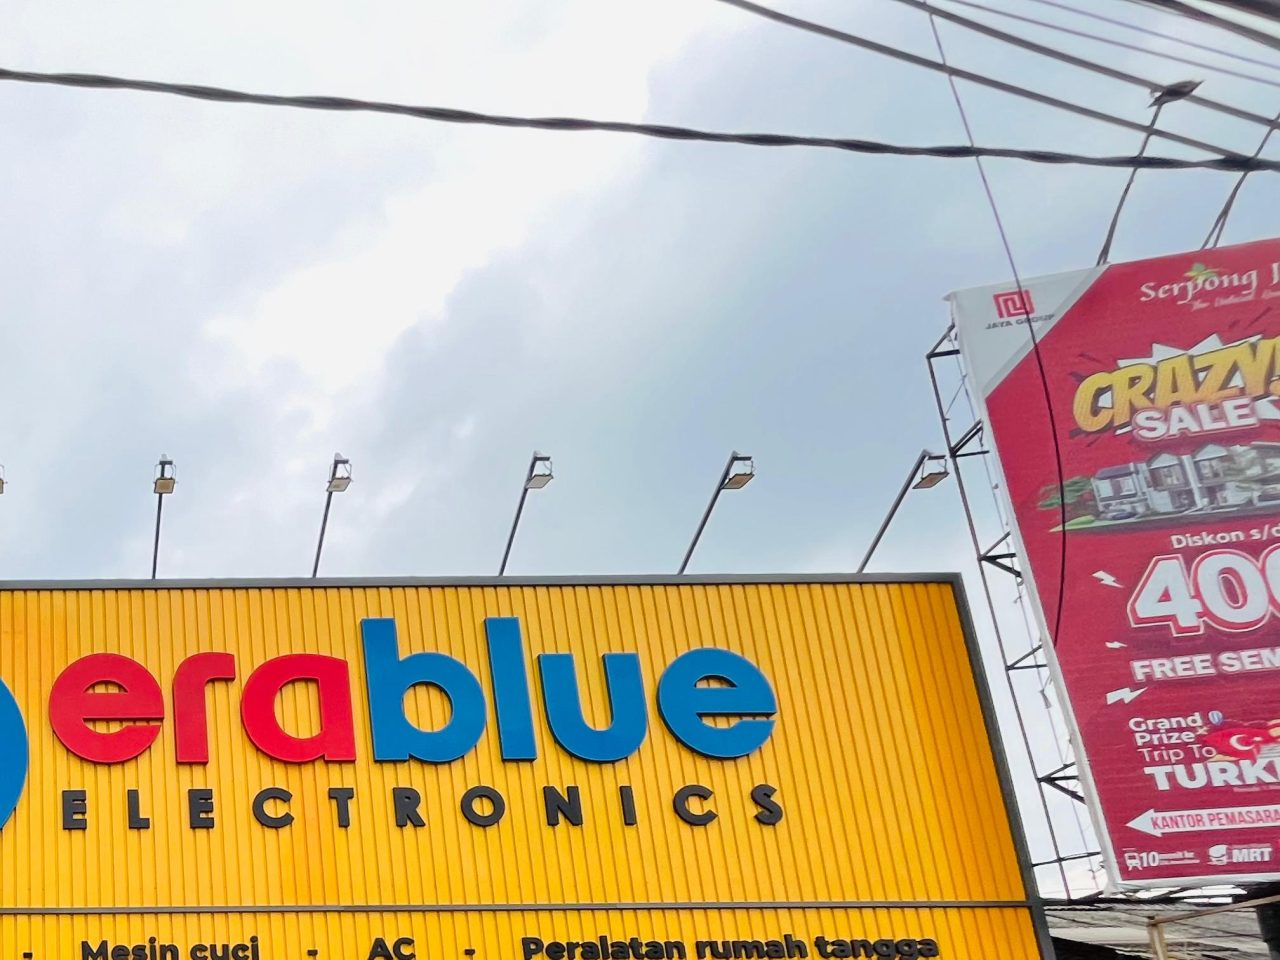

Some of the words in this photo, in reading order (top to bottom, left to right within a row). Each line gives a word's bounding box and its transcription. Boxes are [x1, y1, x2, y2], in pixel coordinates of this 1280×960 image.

[1140, 269, 1258, 304] Serpong
[1134, 398, 1258, 438] SALE
[1171, 530, 1245, 548] Diskon
[1129, 543, 1280, 636] 40
[1132, 654, 1215, 681] FREE
[49, 616, 777, 764] erablue
[1129, 712, 1202, 731] Grand
[1135, 730, 1195, 746] Prize
[1137, 747, 1184, 763] Trip
[1187, 744, 1217, 758] To
[61, 784, 784, 830] ELECTRONICS
[1150, 813, 1205, 830] KANTOR
[1139, 851, 1159, 867] 10
[1232, 848, 1273, 863] MRT
[695, 935, 808, 960] rumah
